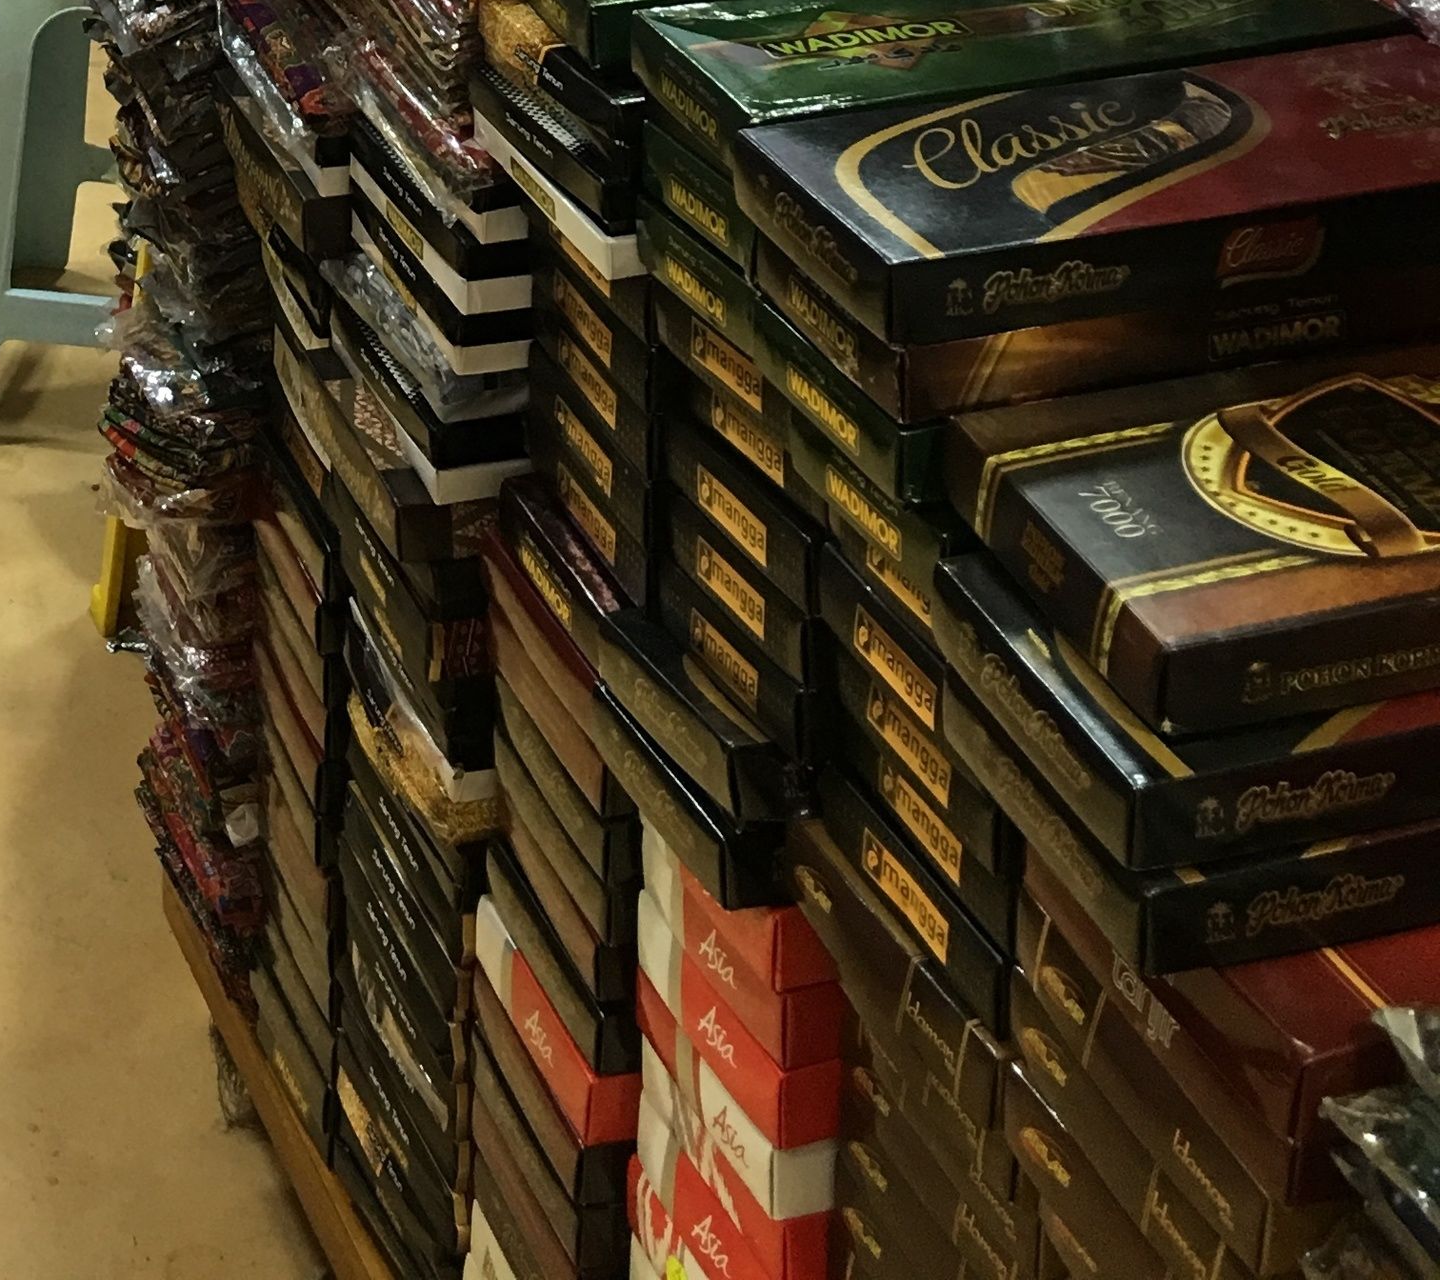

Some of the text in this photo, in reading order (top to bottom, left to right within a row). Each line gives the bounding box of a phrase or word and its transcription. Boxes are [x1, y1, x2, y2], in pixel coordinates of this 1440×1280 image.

[767, 21, 964, 56] WADIMOR
[661, 71, 720, 143] WADIMOR
[902, 100, 1137, 190] Classic
[670, 179, 727, 244] WADIMOR
[666, 255, 725, 326] WADIMOR
[790, 278, 857, 358] WADIMOR
[566, 294, 611, 354] mangga
[1211, 315, 1341, 357] WADIMOR
[568, 351, 616, 414] mangga
[706, 338, 761, 396] mangga
[789, 367, 858, 449] WADIMOR
[725, 414, 782, 472] mangga
[711, 486, 765, 550] mangga
[828, 468, 899, 556] WADIMOR
[1077, 483, 1147, 539] 7000
[521, 545, 570, 625] WADIMOR
[711, 558, 764, 620] mangga
[703, 628, 757, 696] mangga
[870, 638, 933, 709] mangga
[885, 713, 949, 788] mangga
[898, 788, 960, 867] mangga
[882, 859, 946, 947] mangga
[698, 929, 738, 990] Asia
[524, 1009, 554, 1069] Asia
[697, 1006, 738, 1069] Asia
[712, 1106, 750, 1169] Asia
[692, 1214, 732, 1280] Asia
